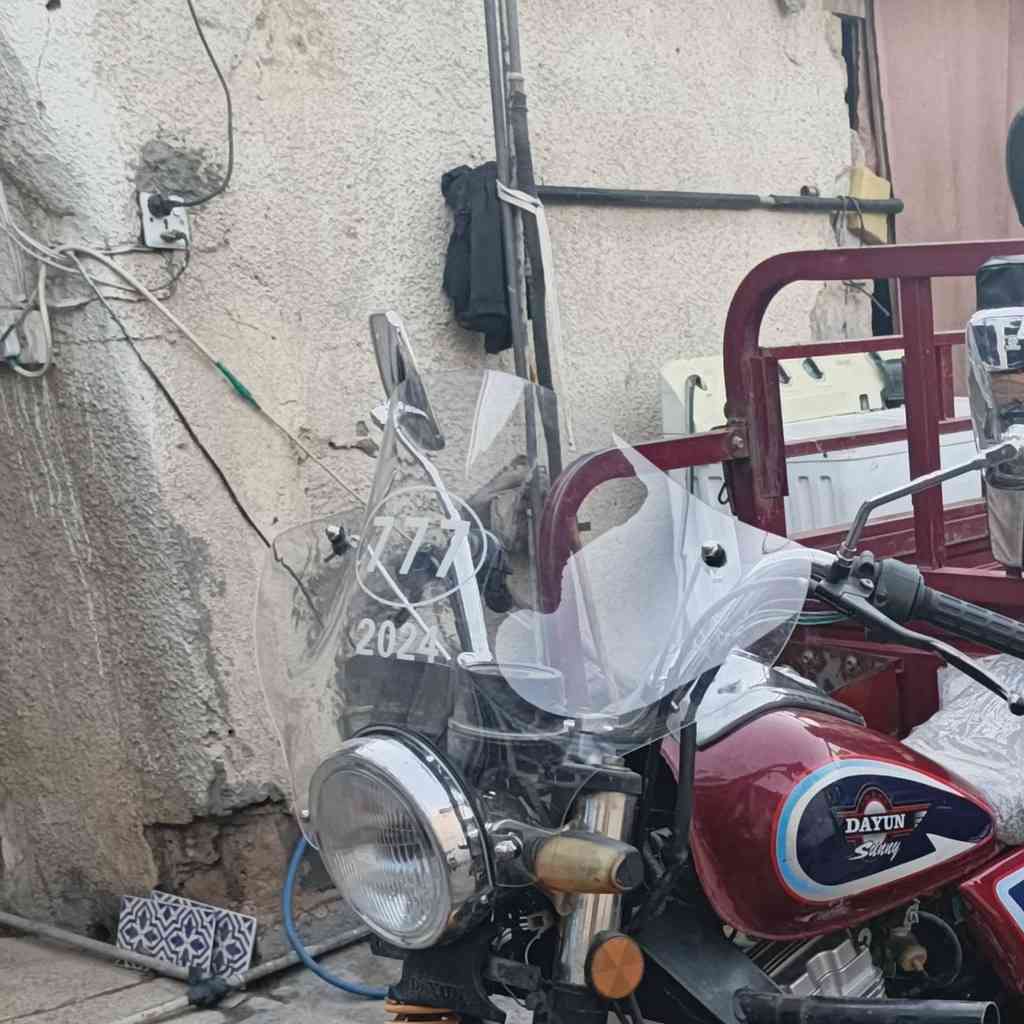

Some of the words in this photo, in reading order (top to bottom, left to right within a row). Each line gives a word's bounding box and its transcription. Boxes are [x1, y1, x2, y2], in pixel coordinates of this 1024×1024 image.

[368, 515, 471, 578] 777
[350, 617, 440, 664] 2024
[844, 813, 906, 835] DAYUN
[848, 839, 902, 862] Sunny
